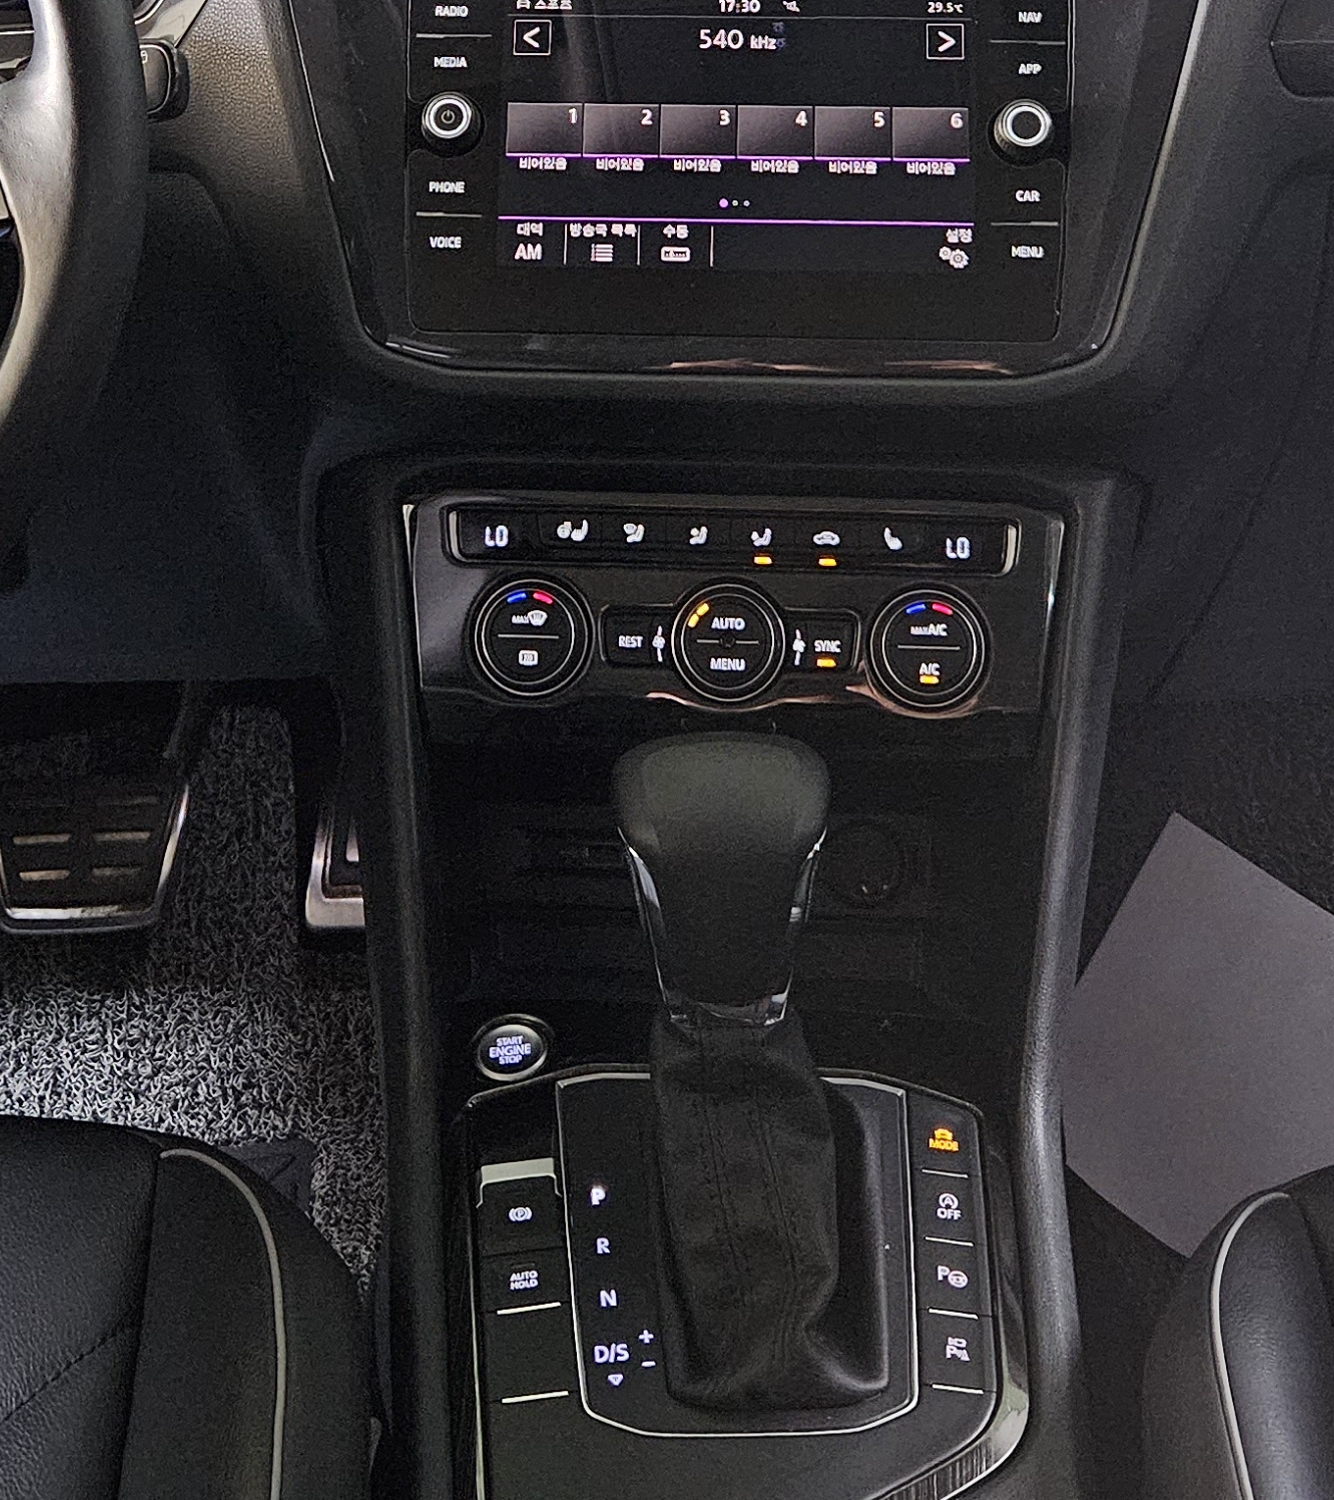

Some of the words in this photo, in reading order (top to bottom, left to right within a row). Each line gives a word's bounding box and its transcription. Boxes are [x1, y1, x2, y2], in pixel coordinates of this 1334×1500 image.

[435, 5, 469, 18] RADIO
[1018, 11, 1043, 24] NAV
[699, 28, 744, 50] 540
[749, 35, 778, 51] kHz
[433, 56, 468, 69] MEDIA
[1018, 63, 1043, 75] APP
[568, 107, 578, 124] 1
[640, 108, 653, 125] 2
[719, 109, 730, 126] 3
[795, 110, 808, 127] 4
[873, 111, 885, 128] 5
[950, 112, 963, 129] 6
[519, 157, 568, 171] 비어있음
[596, 158, 645, 172] 비어있음
[673, 159, 722, 173] 비어있음
[750, 160, 799, 174] 비어있음
[828, 161, 877, 175] 비어있음
[906, 162, 955, 176] 비어있음
[428, 181, 465, 194] PHONE
[1015, 189, 1041, 202] CAR
[516, 222, 543, 237] 대역
[662, 224, 689, 239] 수동
[946, 228, 973, 244] 설정
[429, 236, 462, 249] VOICE
[514, 243, 543, 261] AM
[1010, 246, 1045, 259] MENU
[484, 524, 509, 548] LO
[945, 536, 971, 560] LO
[511, 614, 529, 625] MAX
[711, 617, 746, 631] AUTO
[618, 634, 644, 649] REST
[814, 639, 842, 653] SYNC
[710, 657, 746, 672] MENU
[919, 662, 941, 676] A/C
[496, 1035, 524, 1047] START
[488, 1043, 532, 1058] ENGINE
[498, 1054, 523, 1065] STOP
[928, 1138, 960, 1152] MODE
[590, 1185, 606, 1206] P
[936, 1208, 962, 1221] OFF
[596, 1237, 611, 1255] R
[509, 1270, 538, 1283] AUTO
[510, 1278, 539, 1290] HOLD
[599, 1288, 618, 1307] N
[593, 1342, 630, 1364] D/S
